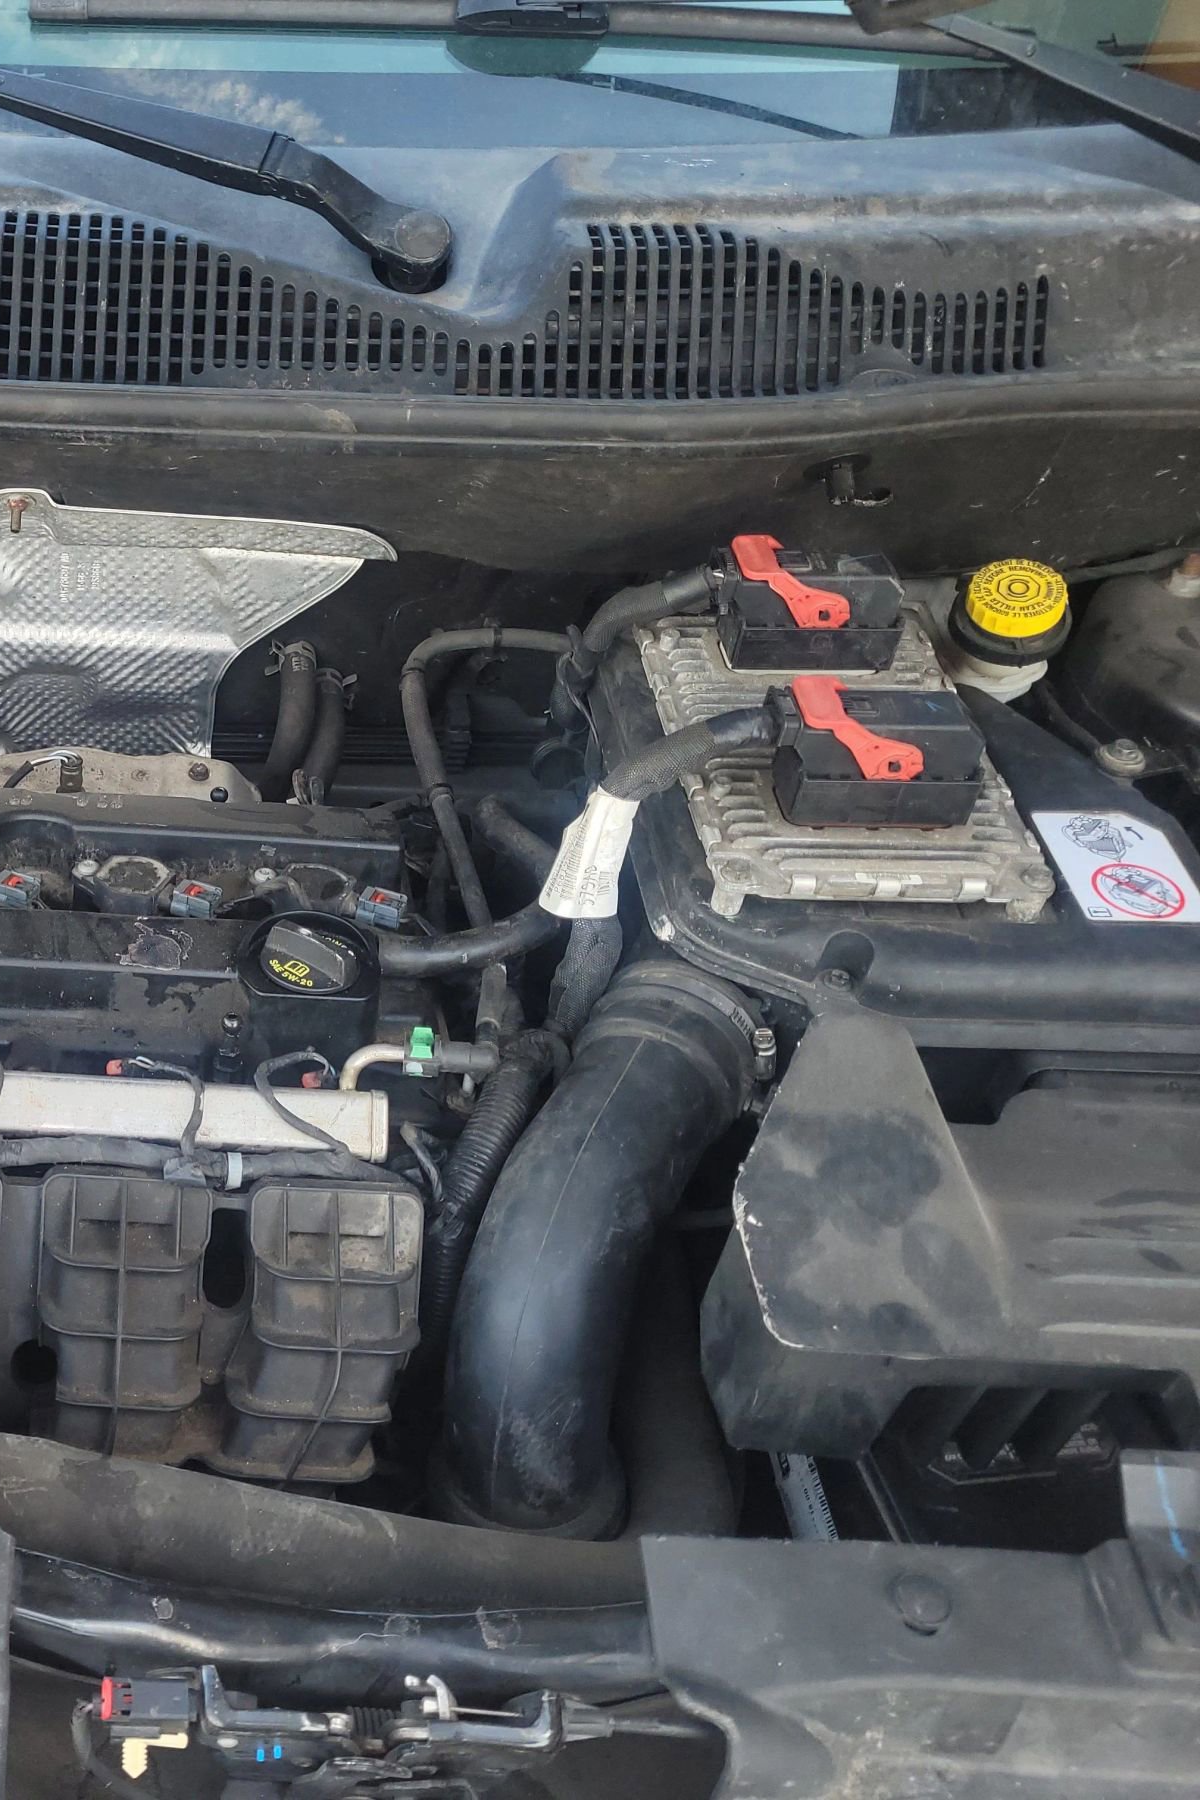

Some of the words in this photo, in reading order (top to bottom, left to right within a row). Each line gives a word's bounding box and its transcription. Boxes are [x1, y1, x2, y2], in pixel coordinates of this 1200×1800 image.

[983, 568, 1005, 585] BEFORE
[1008, 565, 1048, 579] REMOVING
[990, 597, 1016, 612] FILLER
[1019, 601, 1046, 612] CLEAN
[269, 959, 285, 974] SAE
[281, 969, 313, 988] 5W-20
